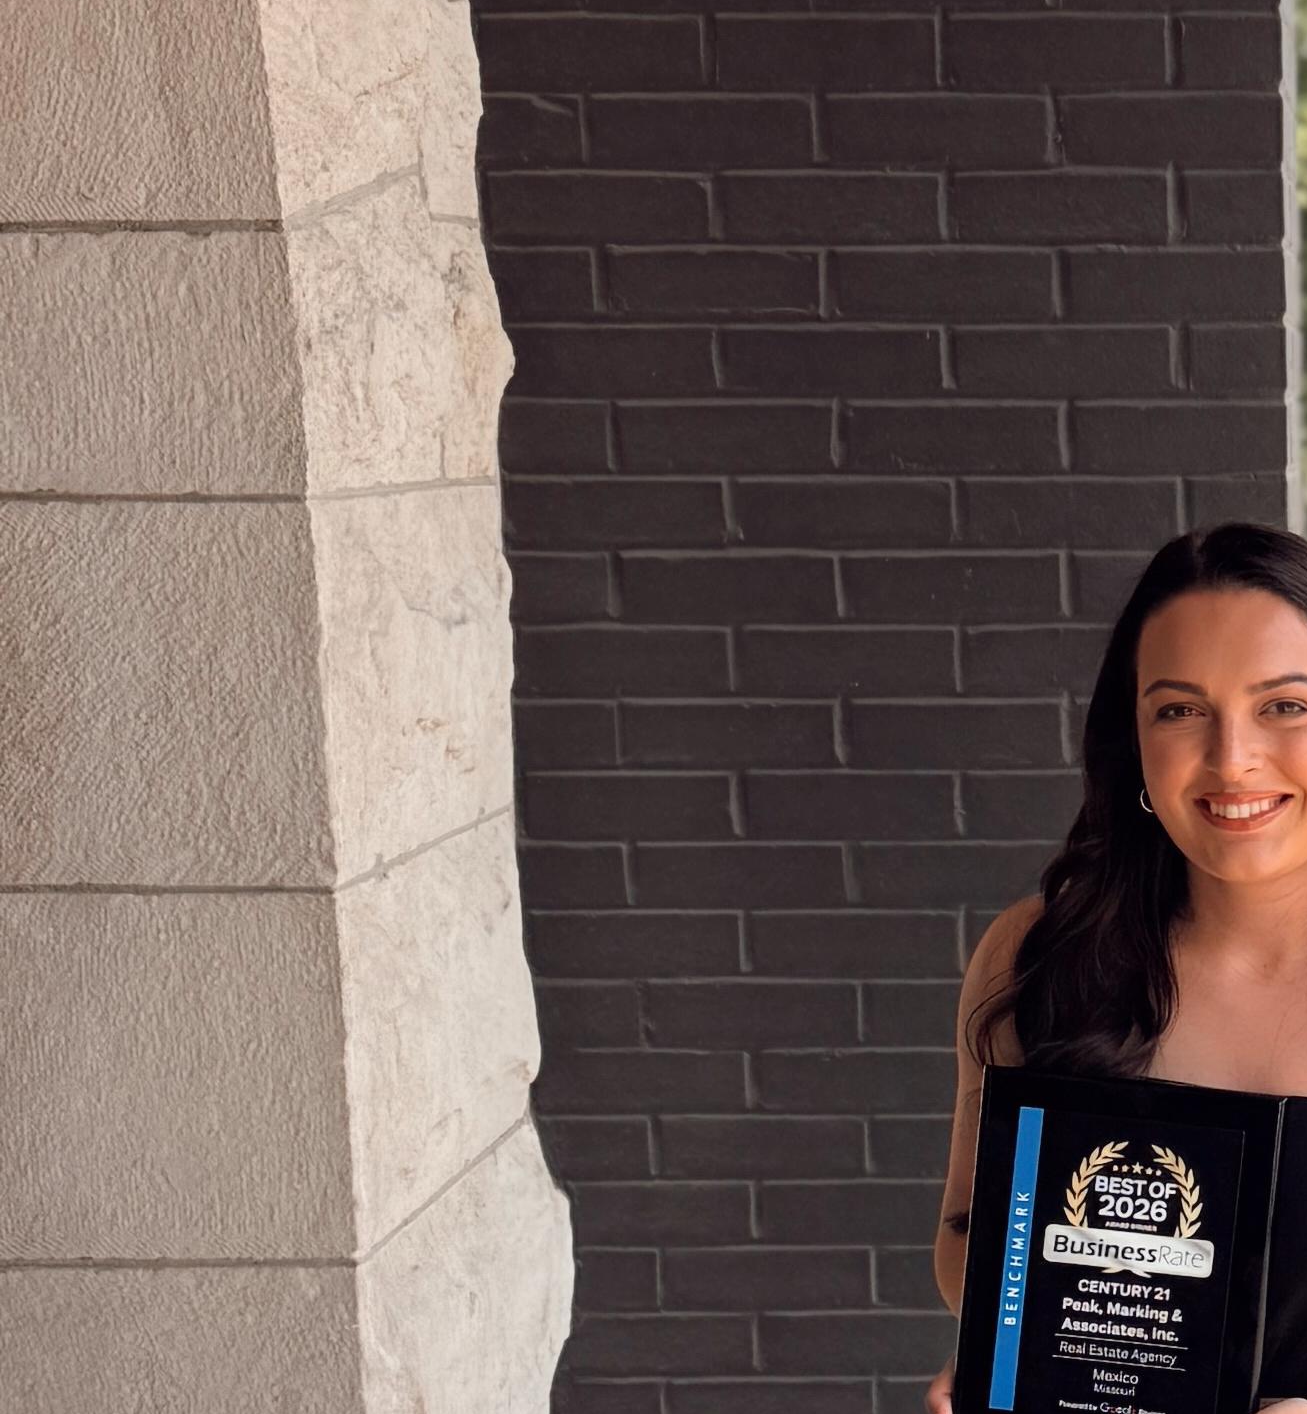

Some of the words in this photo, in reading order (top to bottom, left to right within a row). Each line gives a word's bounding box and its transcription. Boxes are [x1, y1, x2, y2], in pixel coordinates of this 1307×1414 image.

[1094, 1175, 1147, 1197] BEST
[1149, 1181, 1178, 1200] OF
[1098, 1195, 1168, 1222] 2026
[1004, 1191, 1031, 1326] BENCHMARK
[1053, 1234, 1205, 1268] BusinessRate
[1078, 1279, 1152, 1299] CENTURY
[1153, 1287, 1171, 1301] 21
[1062, 1297, 1103, 1316] Peak,
[1106, 1302, 1169, 1324] Marking
[1171, 1309, 1183, 1323] &
[1061, 1317, 1149, 1341] Associates,
[1152, 1327, 1179, 1342] Inc.
[1060, 1341, 1086, 1355] Real
[1089, 1344, 1129, 1360] Estate
[1130, 1349, 1178, 1366] Agency
[1092, 1368, 1139, 1385] Mexico
